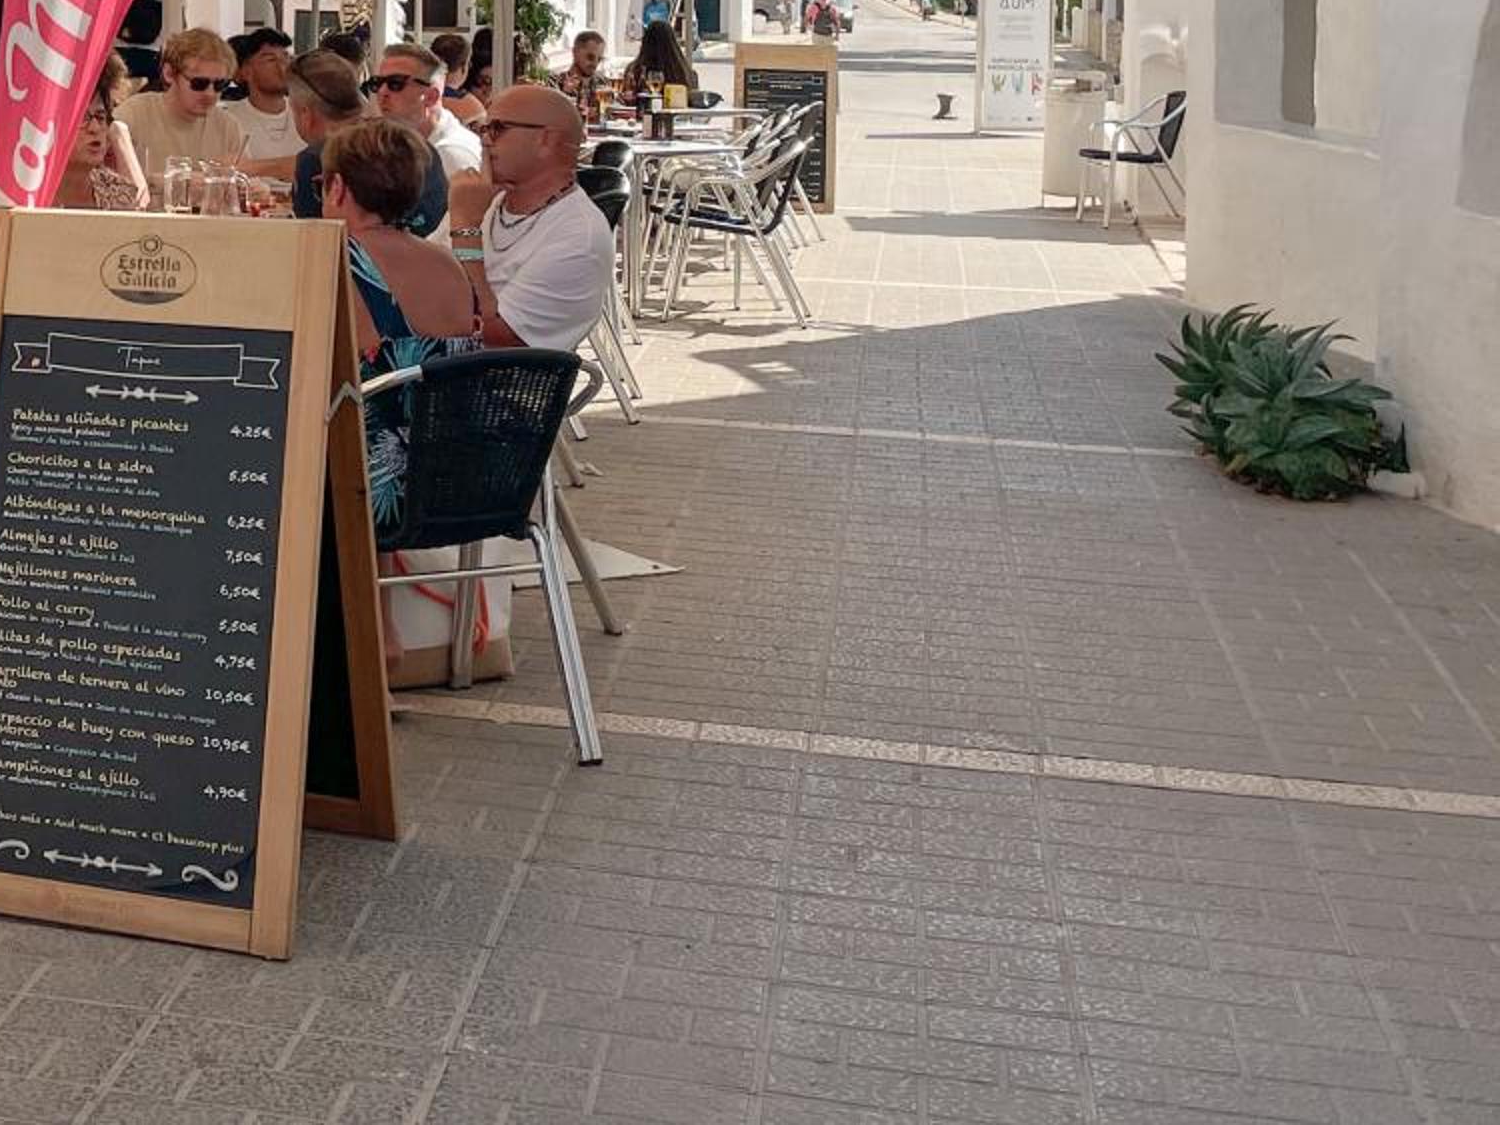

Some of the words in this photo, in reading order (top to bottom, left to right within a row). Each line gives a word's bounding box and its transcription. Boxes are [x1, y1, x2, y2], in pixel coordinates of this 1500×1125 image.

[117, 254, 181, 272] Estrella
[117, 270, 178, 290] Galicia
[13, 408, 60, 423] Patatas
[65, 412, 126, 428] aliñadas
[131, 418, 189, 435] picantes
[7, 452, 78, 468] Choricitos
[83, 460, 92, 469] a
[97, 458, 112, 471] la
[118, 460, 154, 474] sidra
[4, 495, 81, 515] Albóndigas
[85, 504, 95, 514] a
[101, 503, 115, 516] la
[121, 508, 205, 527] menorquina
[0, 528, 54, 548] Almejas
[59, 534, 74, 546] al
[79, 535, 119, 554] ajillo
[73, 572, 137, 586] marinera
[35, 599, 50, 612] al
[55, 604, 95, 623] curry
[36, 632, 54, 647] de
[59, 637, 98, 657] pollo
[103, 644, 181, 663] especiadas
[57, 670, 75, 684] de
[79, 673, 130, 690] ternera
[135, 680, 149, 693] al
[155, 683, 185, 697] vino
[57, 717, 76, 731] de
[81, 718, 114, 742] buey
[119, 728, 147, 740] con
[152, 733, 195, 748] queso
[77, 767, 93, 780] al
[98, 769, 140, 792] ajillo
